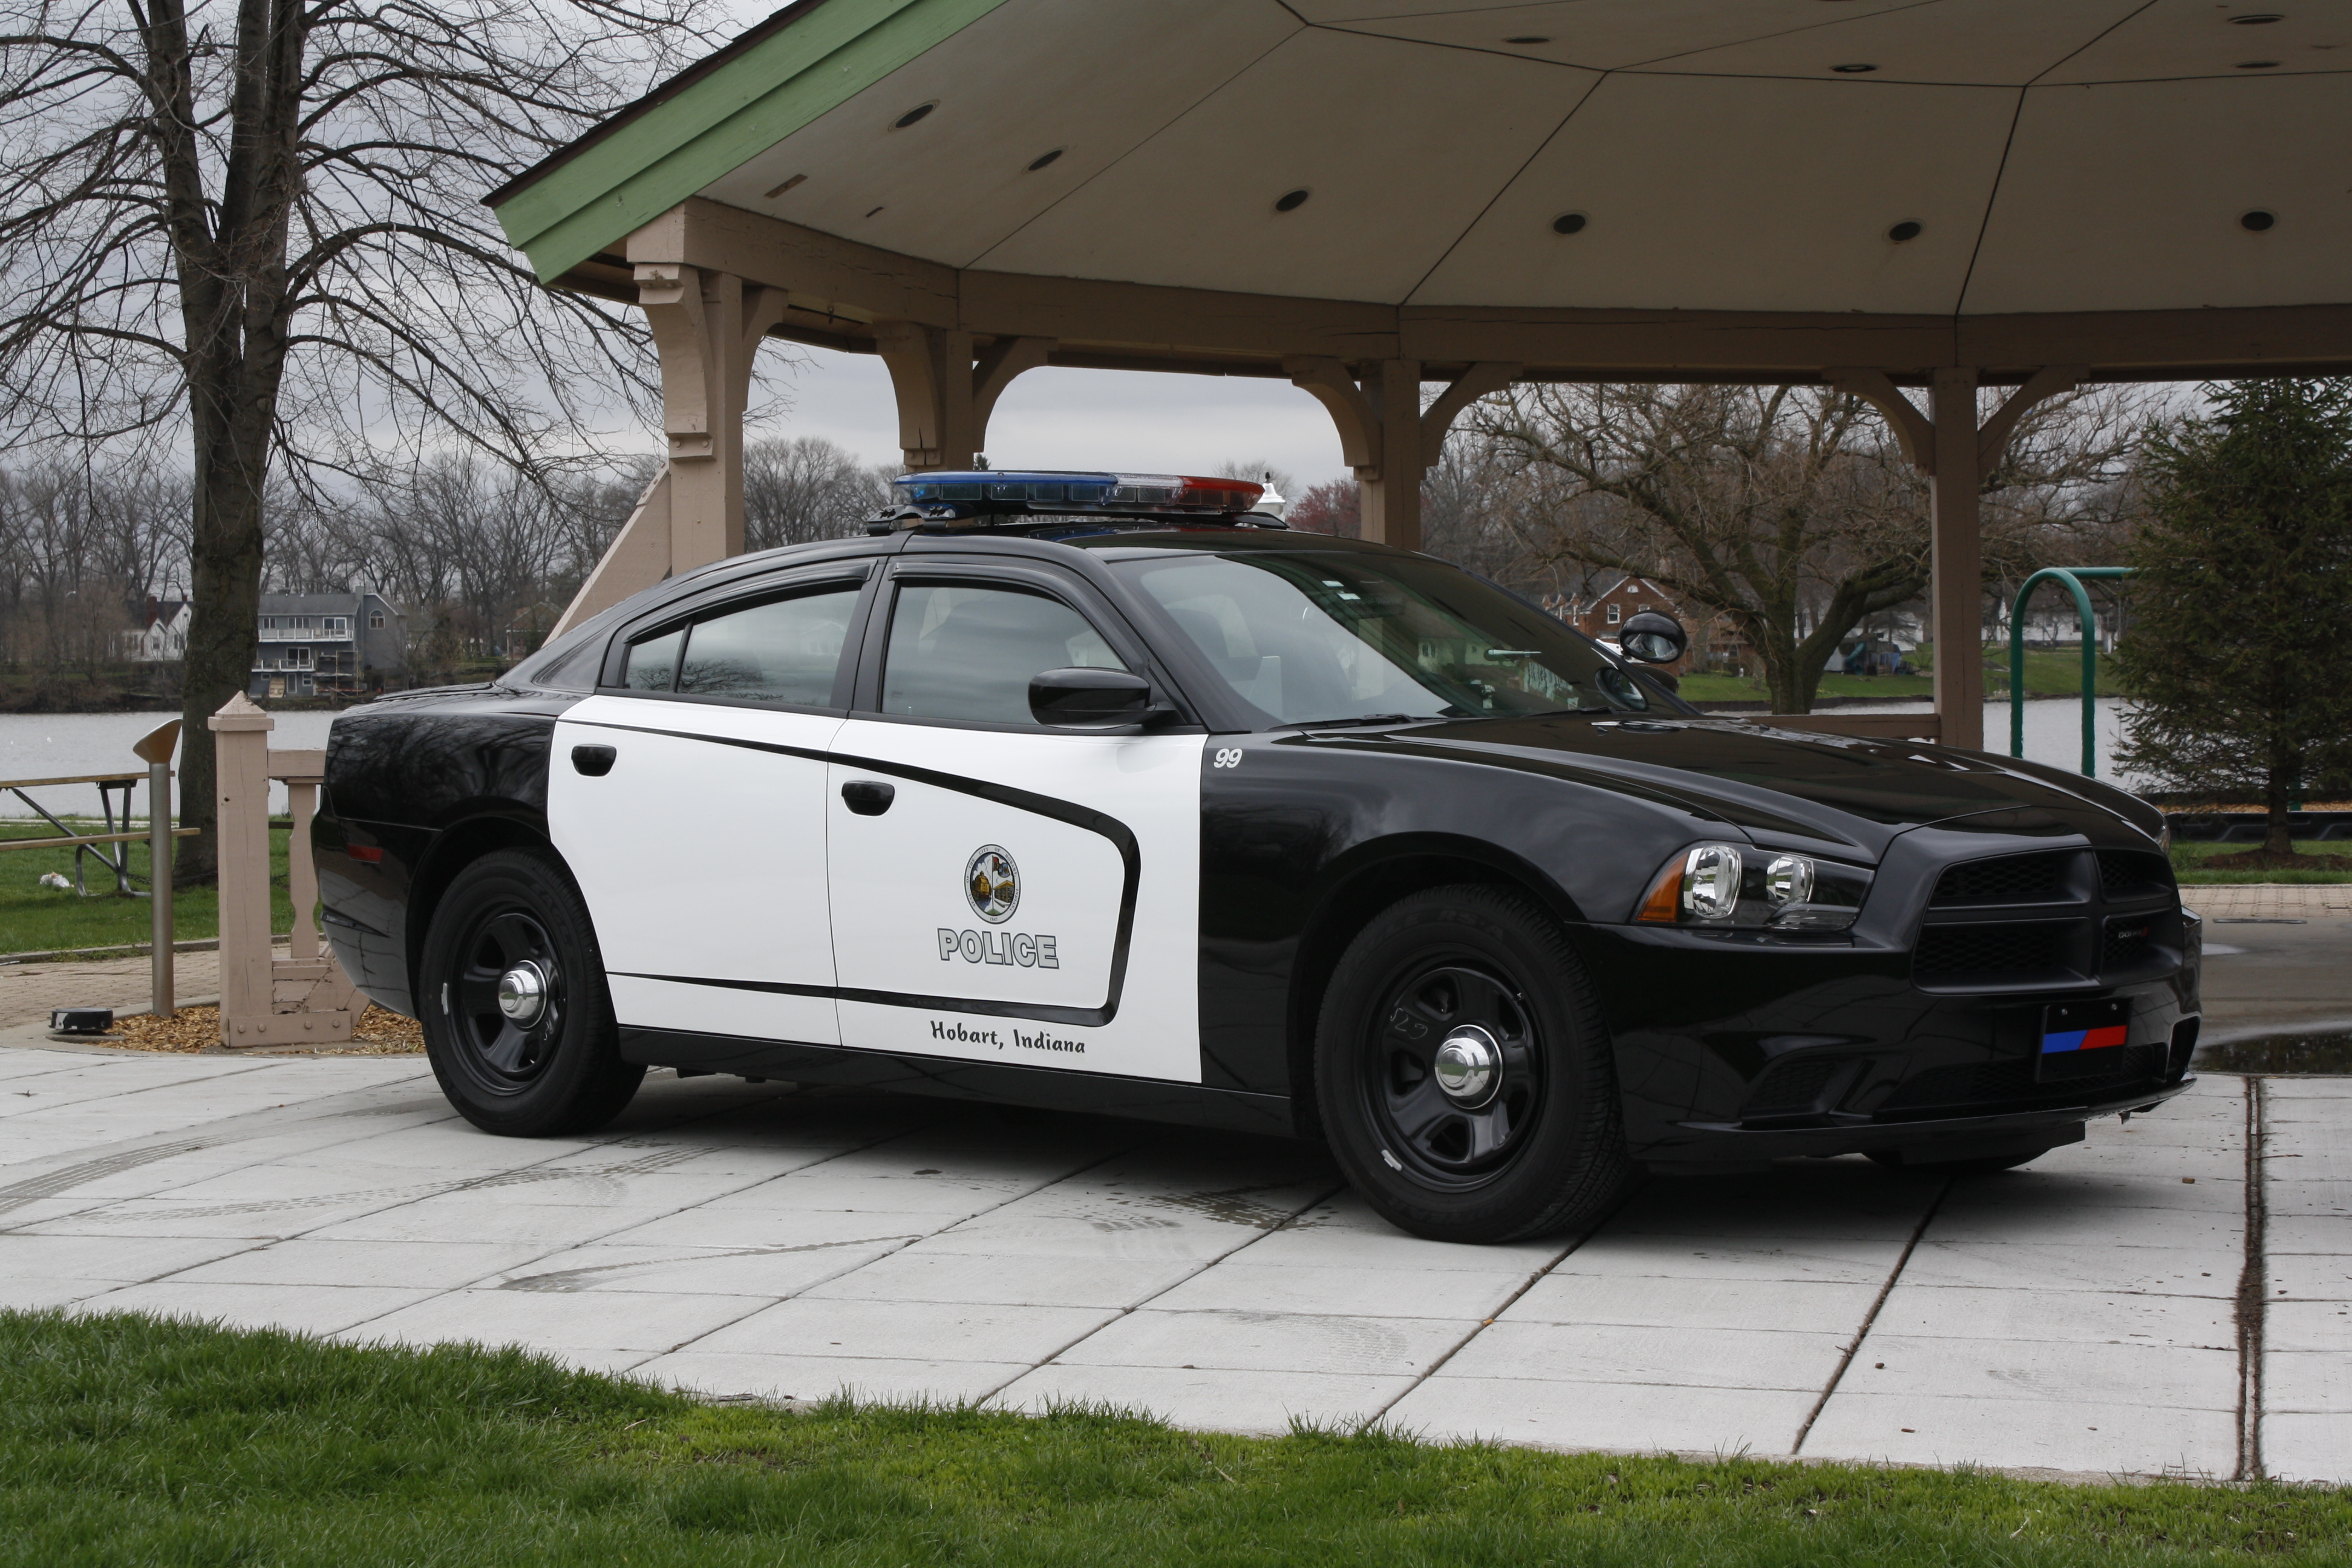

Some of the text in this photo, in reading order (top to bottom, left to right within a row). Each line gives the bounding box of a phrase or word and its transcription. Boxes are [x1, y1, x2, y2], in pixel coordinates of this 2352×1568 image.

[1214, 748, 1243, 768] 99
[1010, 889, 1019, 911] INDIANA
[937, 927, 1060, 969] POLICE
[930, 1020, 1085, 1053] Hobart, Indiana
